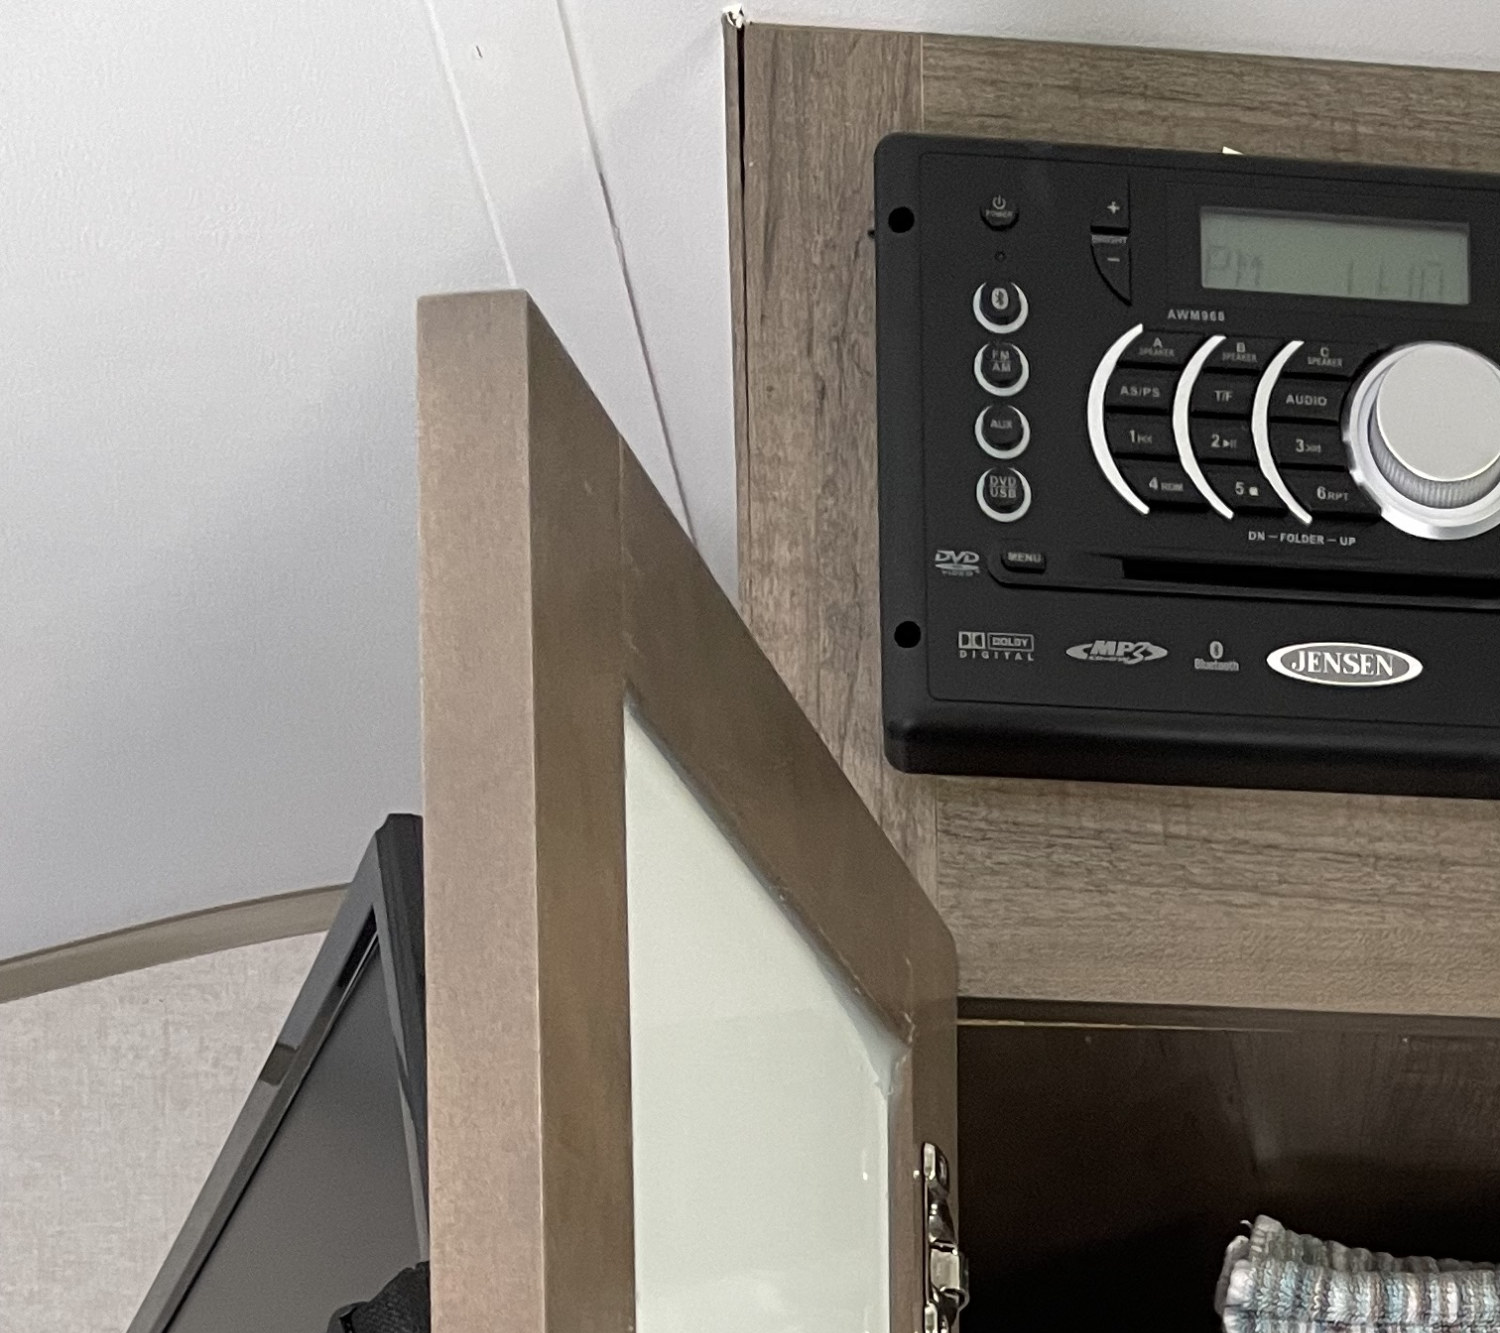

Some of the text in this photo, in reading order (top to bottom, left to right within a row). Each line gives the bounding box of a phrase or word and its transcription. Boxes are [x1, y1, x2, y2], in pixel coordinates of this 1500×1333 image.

[1153, 337, 1163, 348] A
[1236, 342, 1246, 353] B
[991, 350, 1010, 360] FM
[1138, 347, 1175, 358] SPEAKER
[1222, 352, 1257, 363] SPEAKER
[1320, 347, 1330, 358] C
[991, 362, 1011, 372] AM
[1307, 357, 1343, 368] SPEAKER
[1120, 386, 1161, 398] AS/PS
[1215, 390, 1233, 402] T/F
[1286, 394, 1328, 407] AUDIO
[990, 419, 1013, 429] AUX
[1129, 429, 1136, 444] 1
[1211, 434, 1220, 449] 2
[1295, 438, 1305, 453] 3
[989, 475, 1017, 487] DVD
[1149, 477, 1158, 490] 4
[989, 488, 1017, 499] USB
[1235, 482, 1244, 495] 5
[1317, 486, 1349, 501] 6 RPT
[1248, 531, 1356, 547] DN FOLDER UP
[935, 549, 980, 564] DVD
[1007, 551, 1042, 563] MENU
[992, 636, 1029, 647] DOLBY
[959, 650, 1034, 661] DIGITAL
[1090, 640, 1151, 665] MP3
[1291, 650, 1394, 677] JENSEN
